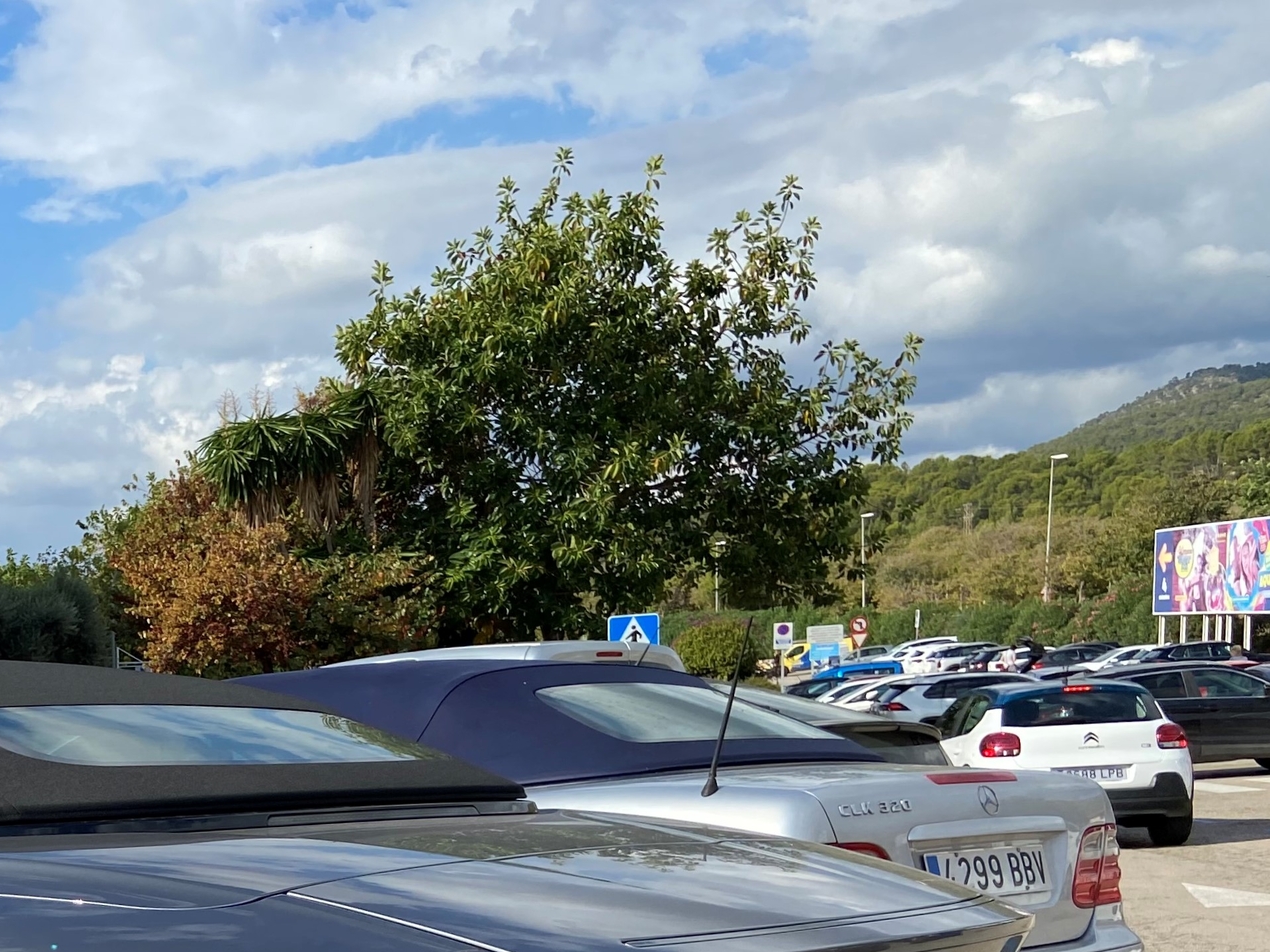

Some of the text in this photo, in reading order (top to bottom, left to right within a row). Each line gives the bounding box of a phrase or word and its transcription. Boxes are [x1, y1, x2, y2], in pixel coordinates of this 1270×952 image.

[1100, 768, 1124, 779] LPB
[838, 798, 913, 817] CLK 320
[1007, 851, 1046, 886] BBV
